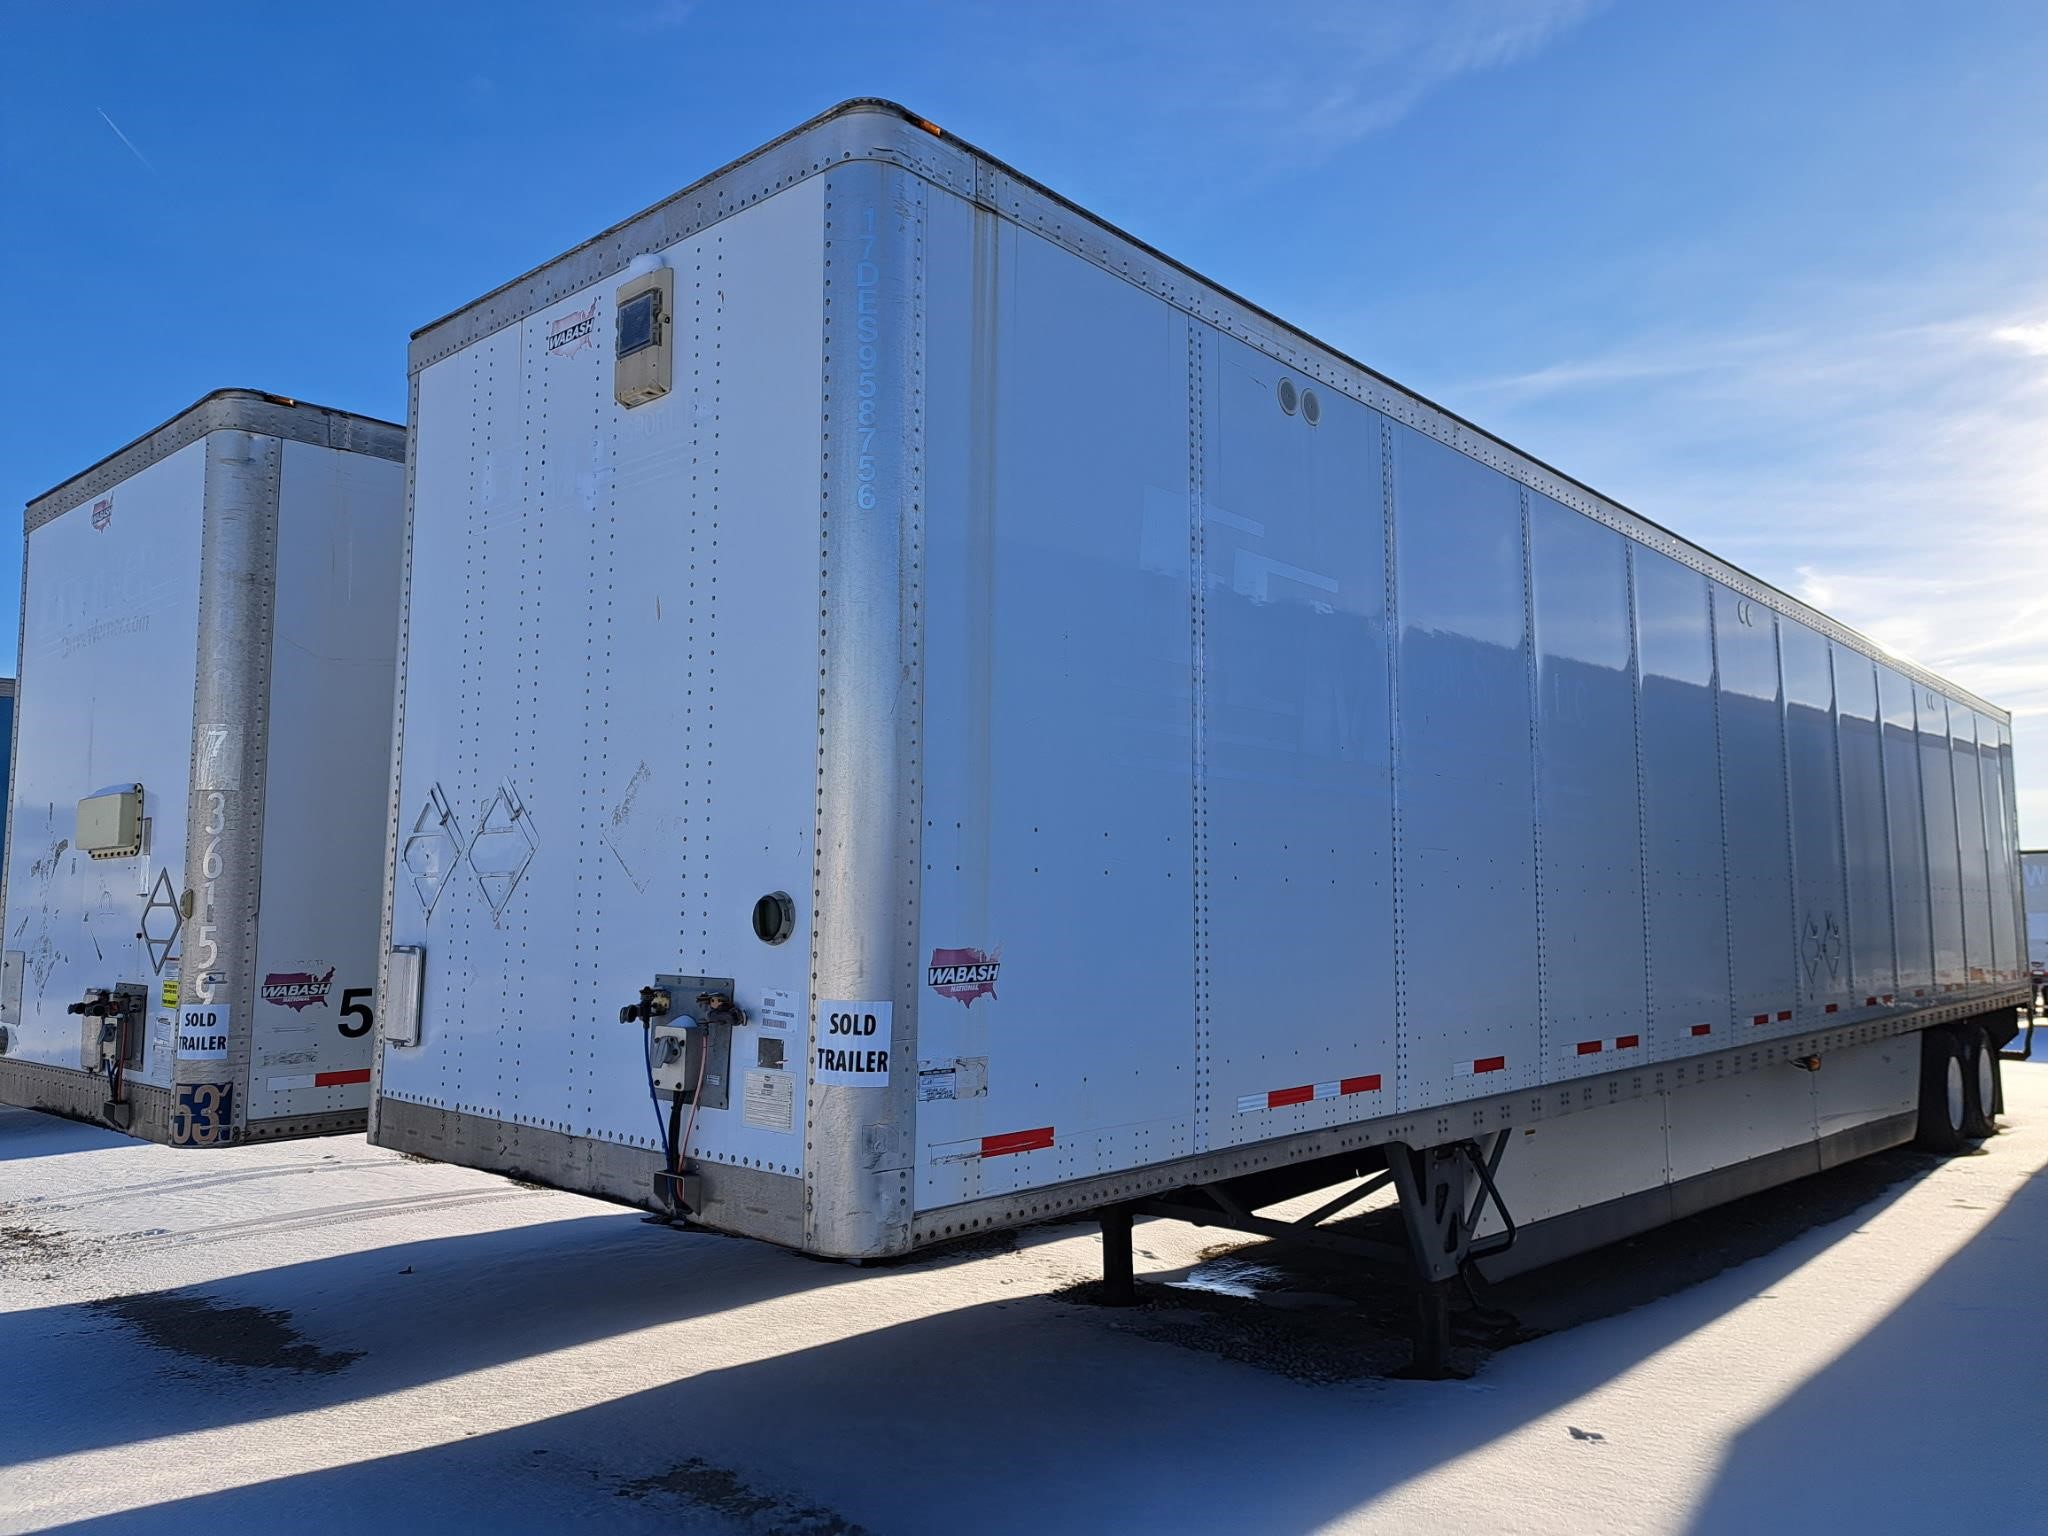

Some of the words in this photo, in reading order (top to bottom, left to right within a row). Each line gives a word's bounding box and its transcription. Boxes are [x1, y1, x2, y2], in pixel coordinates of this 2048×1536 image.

[549, 320, 593, 350] WABASH
[929, 964, 999, 985] WABASH
[262, 983, 331, 998] WABASH
[185, 1013, 217, 1027] SOLD
[338, 988, 374, 1038] 5
[829, 1012, 877, 1036] SOLD
[179, 1035, 227, 1051] TRAILER
[817, 1047, 889, 1073] TRAILER
